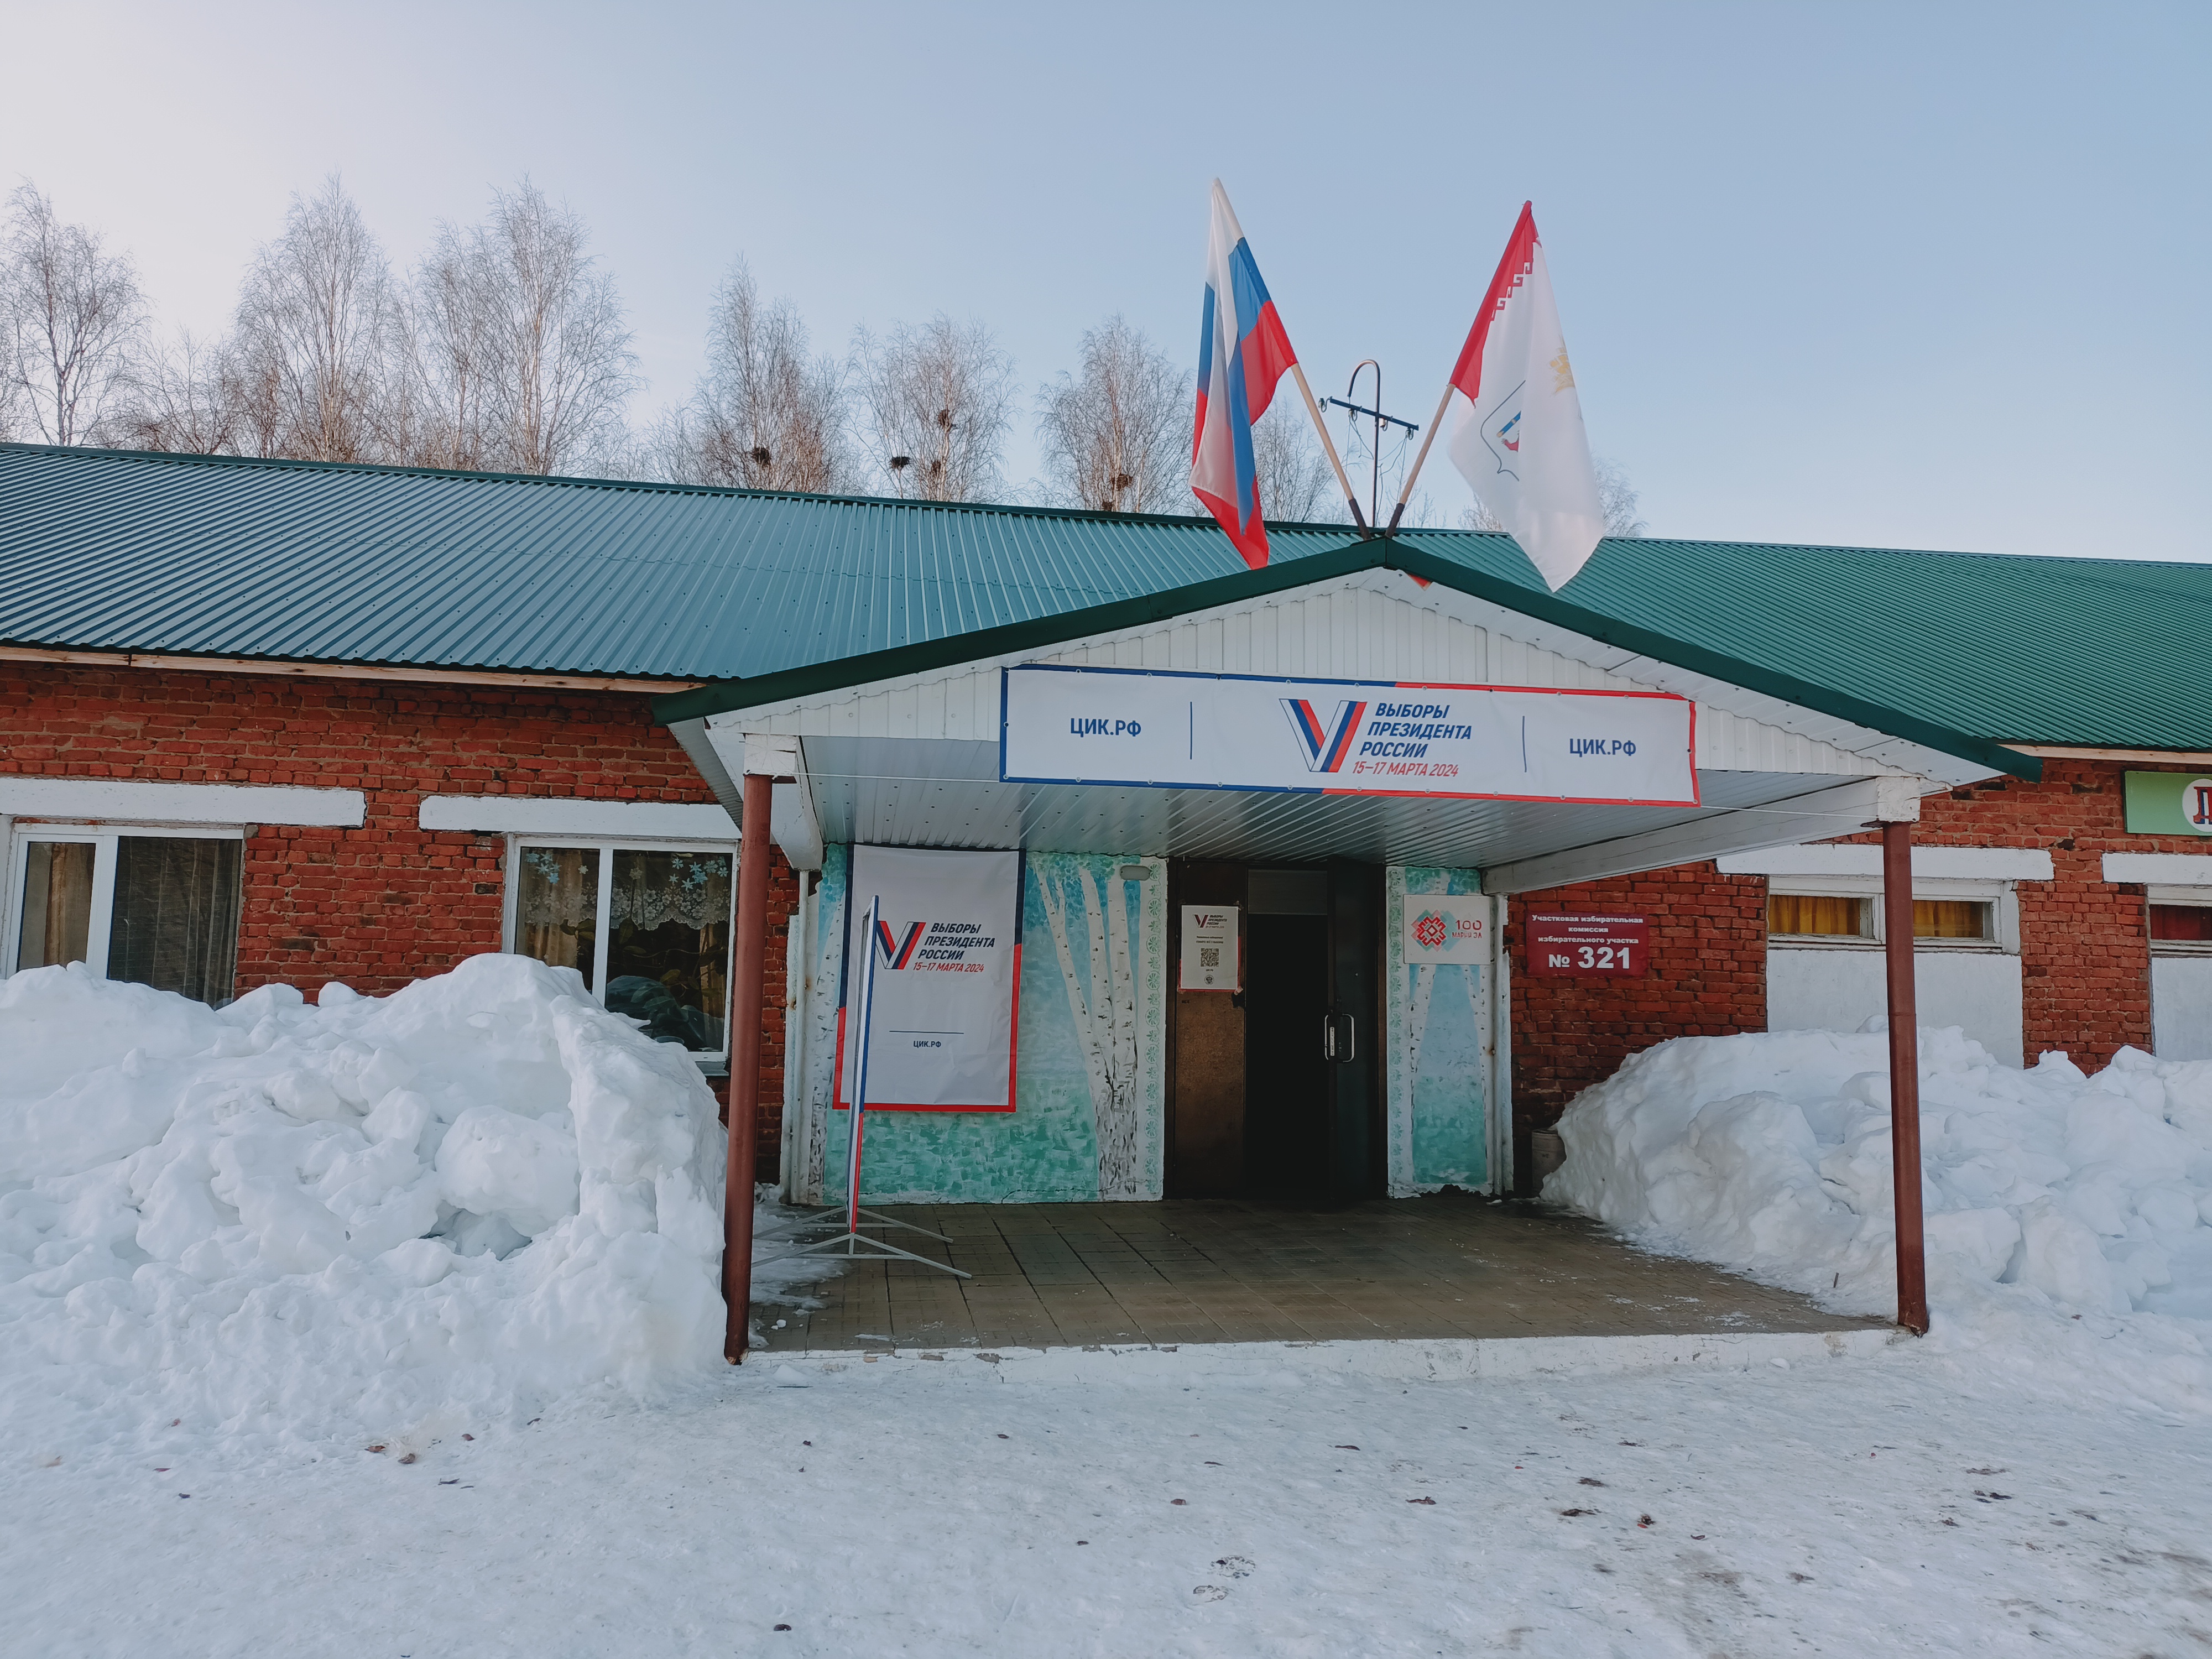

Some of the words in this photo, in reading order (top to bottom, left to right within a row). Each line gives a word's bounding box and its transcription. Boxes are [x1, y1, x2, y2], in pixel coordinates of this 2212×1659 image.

[1375, 702, 1450, 719] ВЫБОРЫ
[1071, 718, 1141, 738] ЦИК.РФ
[1367, 722, 1472, 740] ПРЕЗИДЕНТА
[1359, 741, 1428, 758] РОССИИ
[1569, 738, 1636, 758] ЦИК.РФ
[1386, 762, 1428, 776] МАРТА
[1428, 764, 1459, 778] 2024
[930, 922, 982, 934] ВЫБОРЫ
[1455, 920, 1482, 931] 100
[924, 936, 995, 948] ПРЕЗИДЕНТА
[918, 949, 965, 961] РОССИИ
[1548, 954, 1571, 968] №
[1577, 946, 1630, 969] 321
[936, 963, 964, 972] МАРТА
[964, 963, 985, 973] 2024
[913, 1040, 941, 1048] ЦИК.РФ
